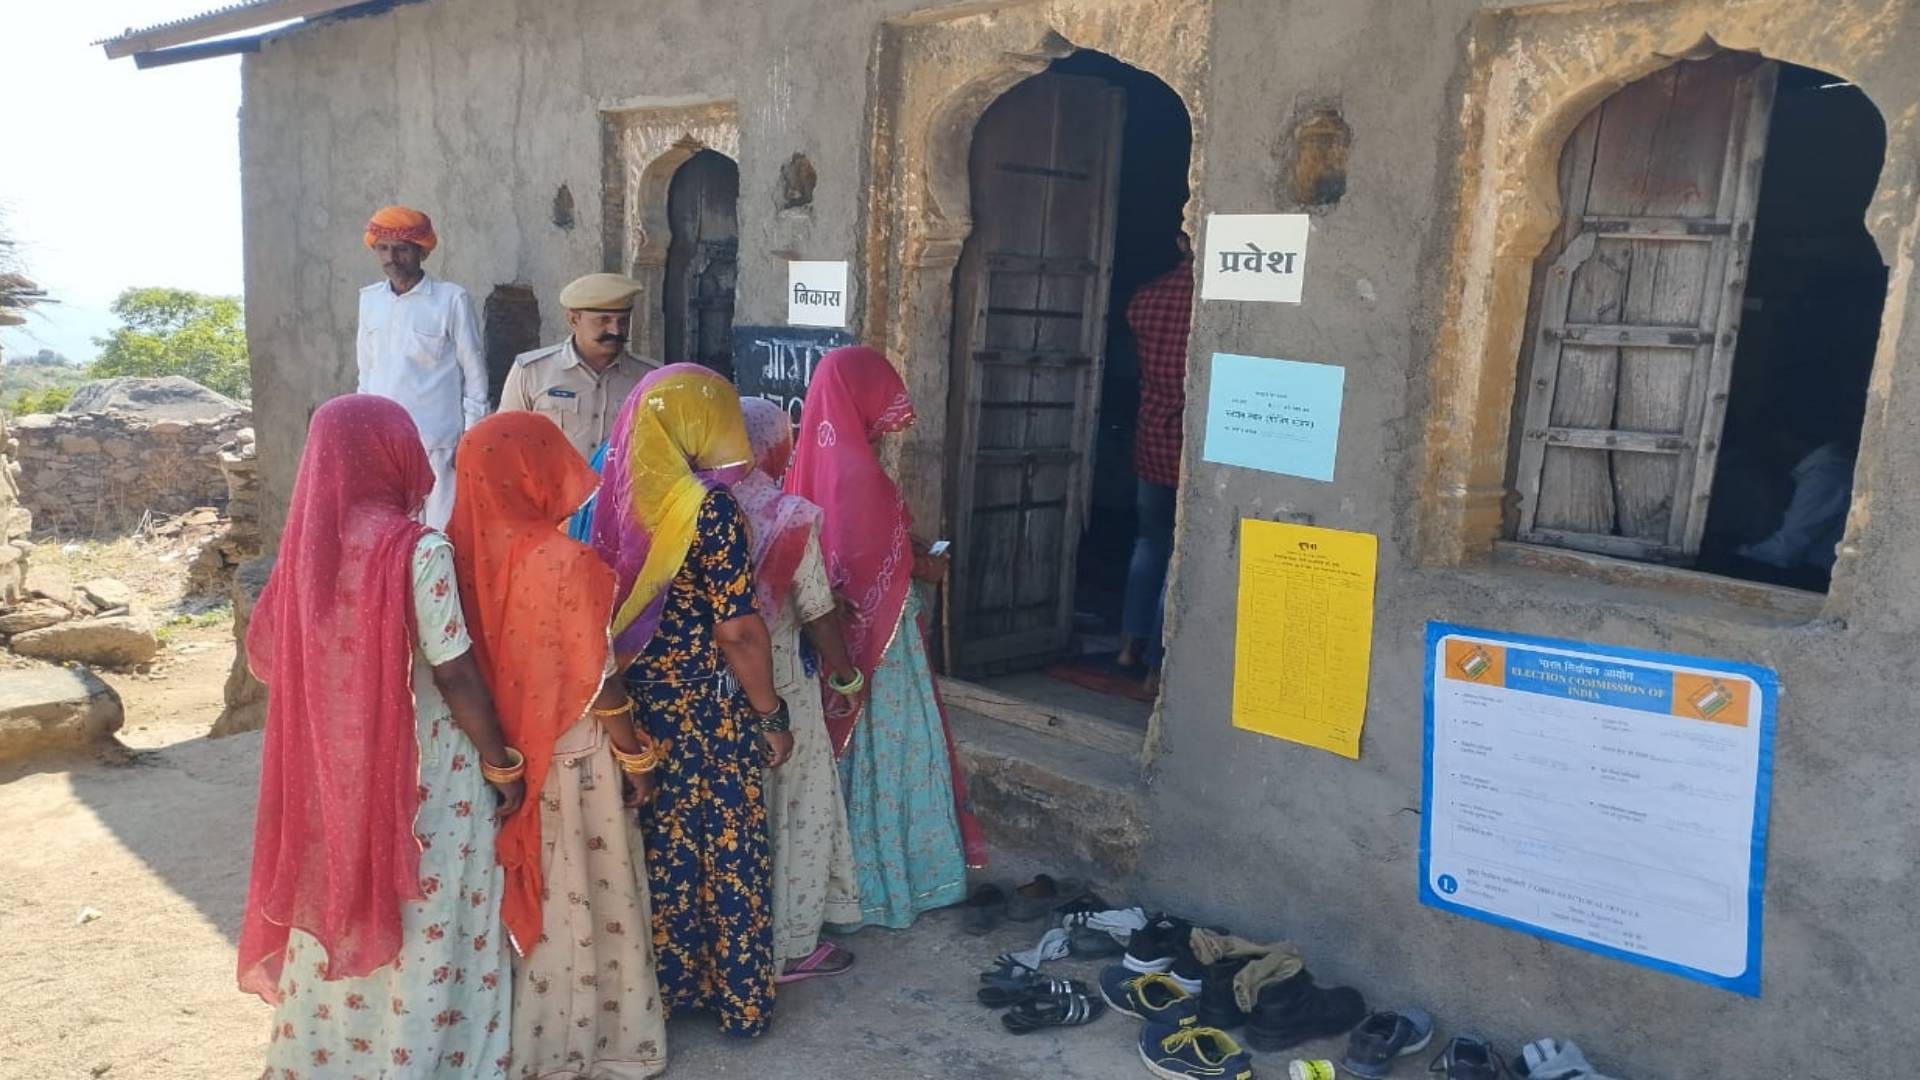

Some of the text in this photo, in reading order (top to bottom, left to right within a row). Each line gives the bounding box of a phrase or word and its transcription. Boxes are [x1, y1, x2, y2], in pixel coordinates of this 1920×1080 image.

[1218, 242, 1297, 274] प्रवेश
[793, 282, 841, 307] निकास
[1511, 667, 1666, 699] ELECTION COMMISSION OF
[1604, 667, 1634, 682] आयोग
[1568, 687, 1601, 700] INDIA
